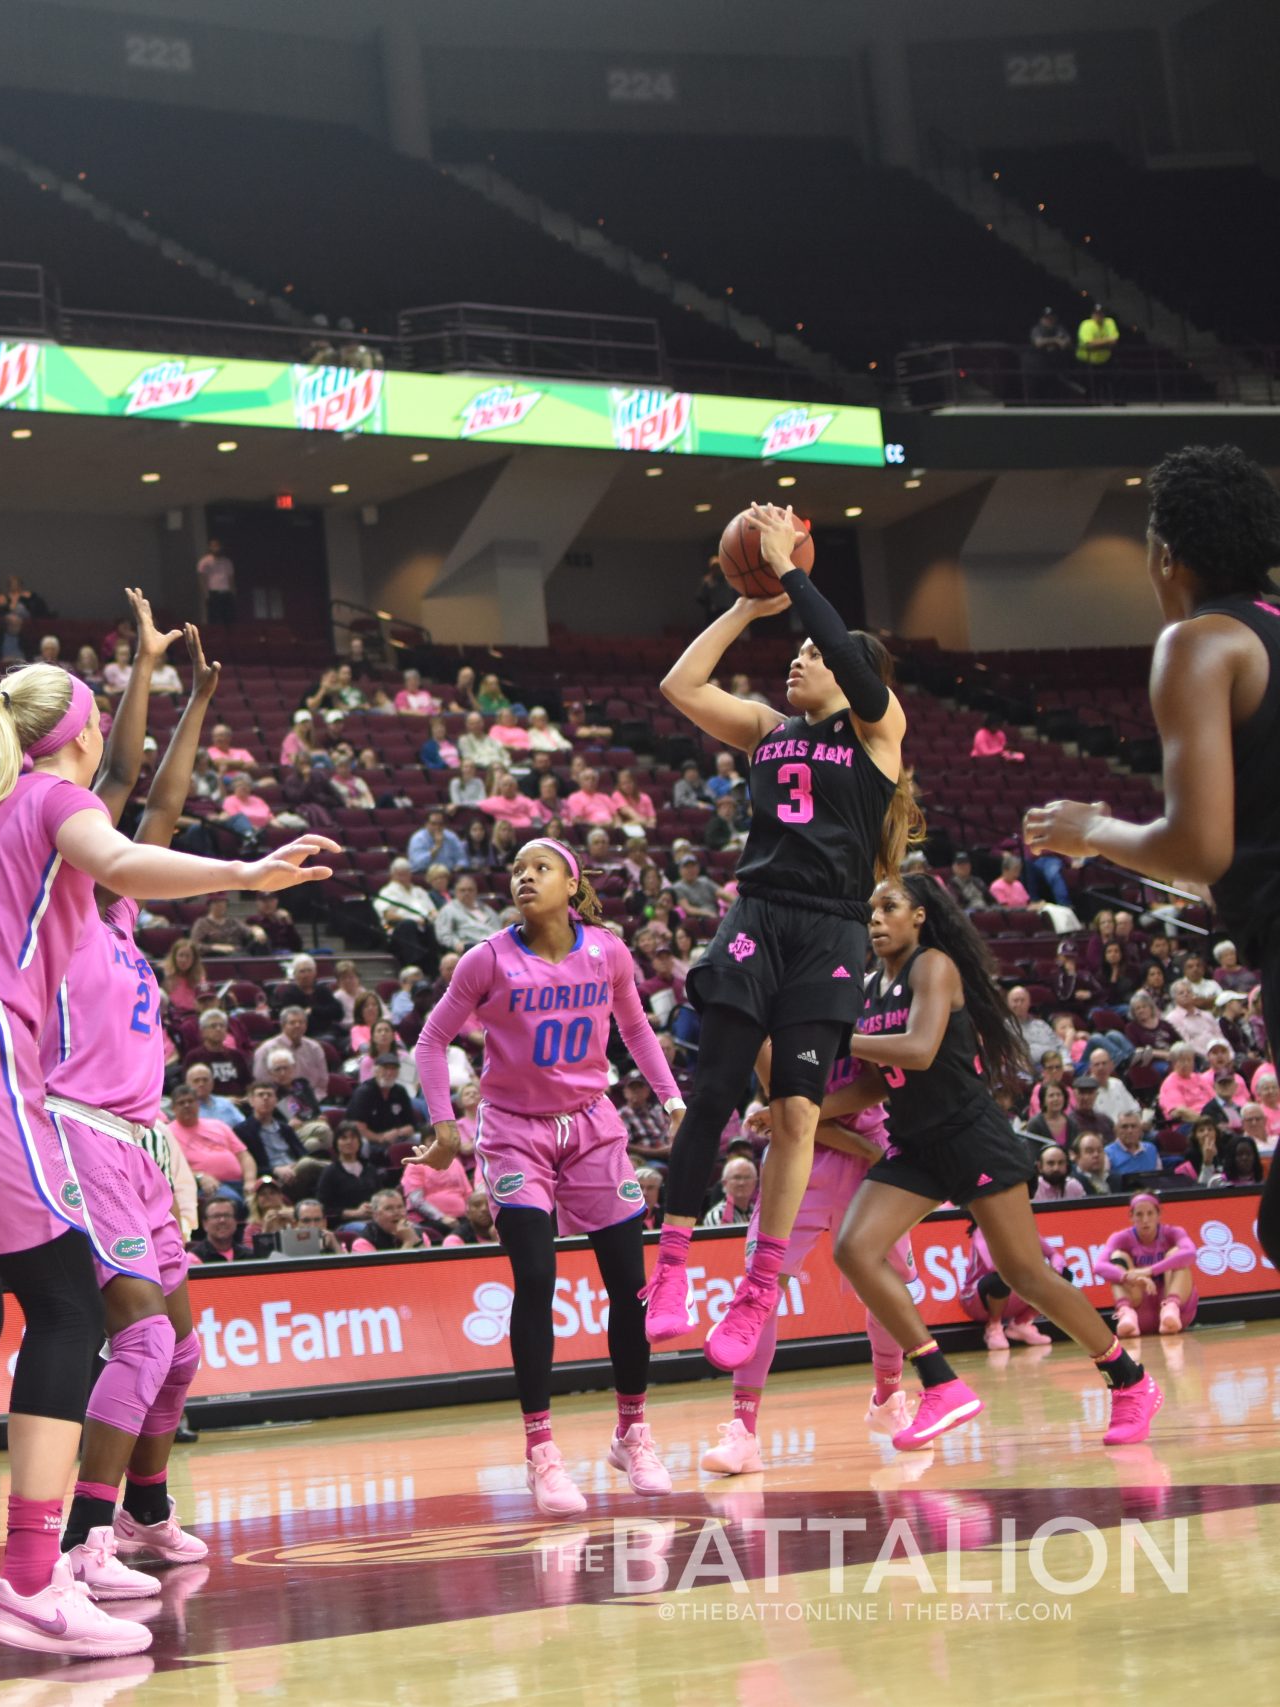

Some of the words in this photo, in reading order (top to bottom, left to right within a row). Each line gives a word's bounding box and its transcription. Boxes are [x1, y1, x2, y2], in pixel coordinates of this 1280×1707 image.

[125, 38, 192, 71] 223
[1007, 54, 1078, 84] 225
[607, 70, 675, 101] 224
[754, 740, 809, 765] TEXAS
[812, 743, 854, 768] A&M
[777, 763, 813, 824] 3
[508, 981, 608, 1013] FLORIDA
[532, 1016, 593, 1068] 00
[261, 1300, 403, 1364] Farm
